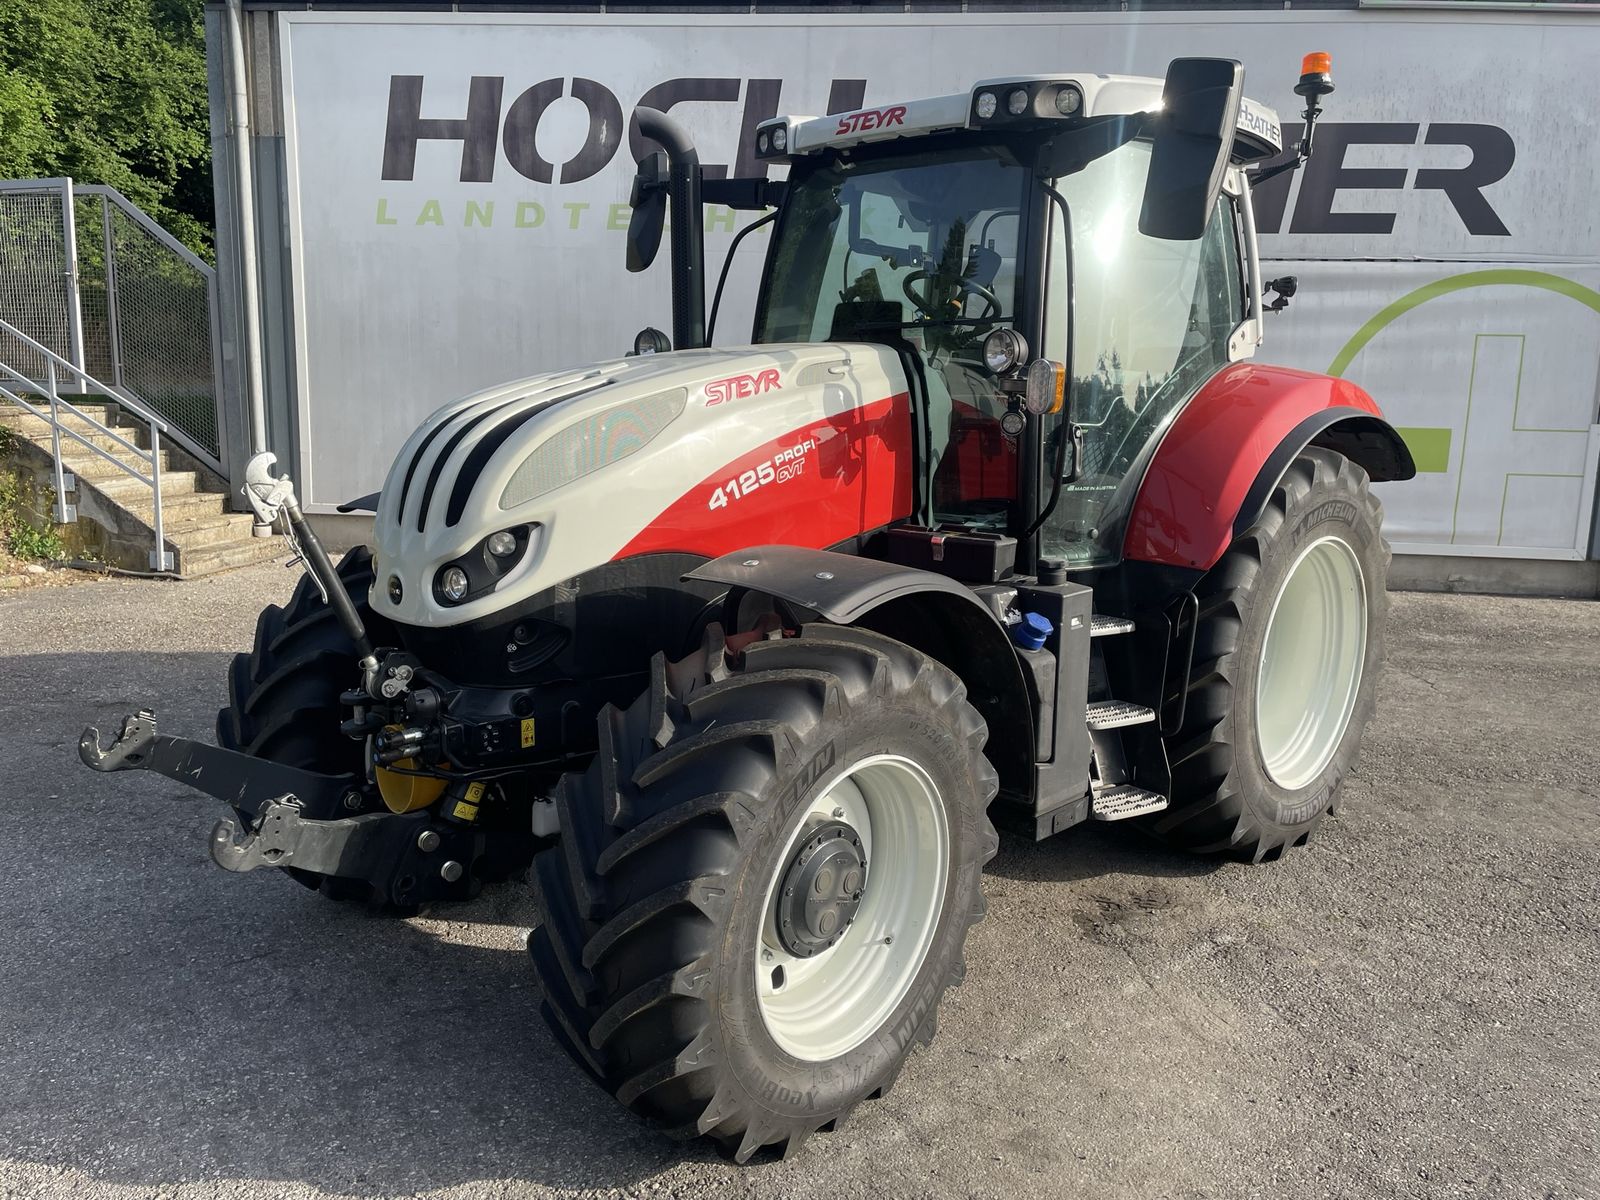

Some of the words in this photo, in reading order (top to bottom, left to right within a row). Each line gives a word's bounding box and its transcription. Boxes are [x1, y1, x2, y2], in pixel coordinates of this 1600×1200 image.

[835, 106, 907, 135] STEYR
[705, 369, 782, 407] STEYR
[708, 461, 775, 511] 4125
[774, 439, 816, 466] PROFI
[776, 458, 805, 484] CVT
[1307, 502, 1357, 529] MICHELIN
[1280, 785, 1330, 824] MICHELIN
